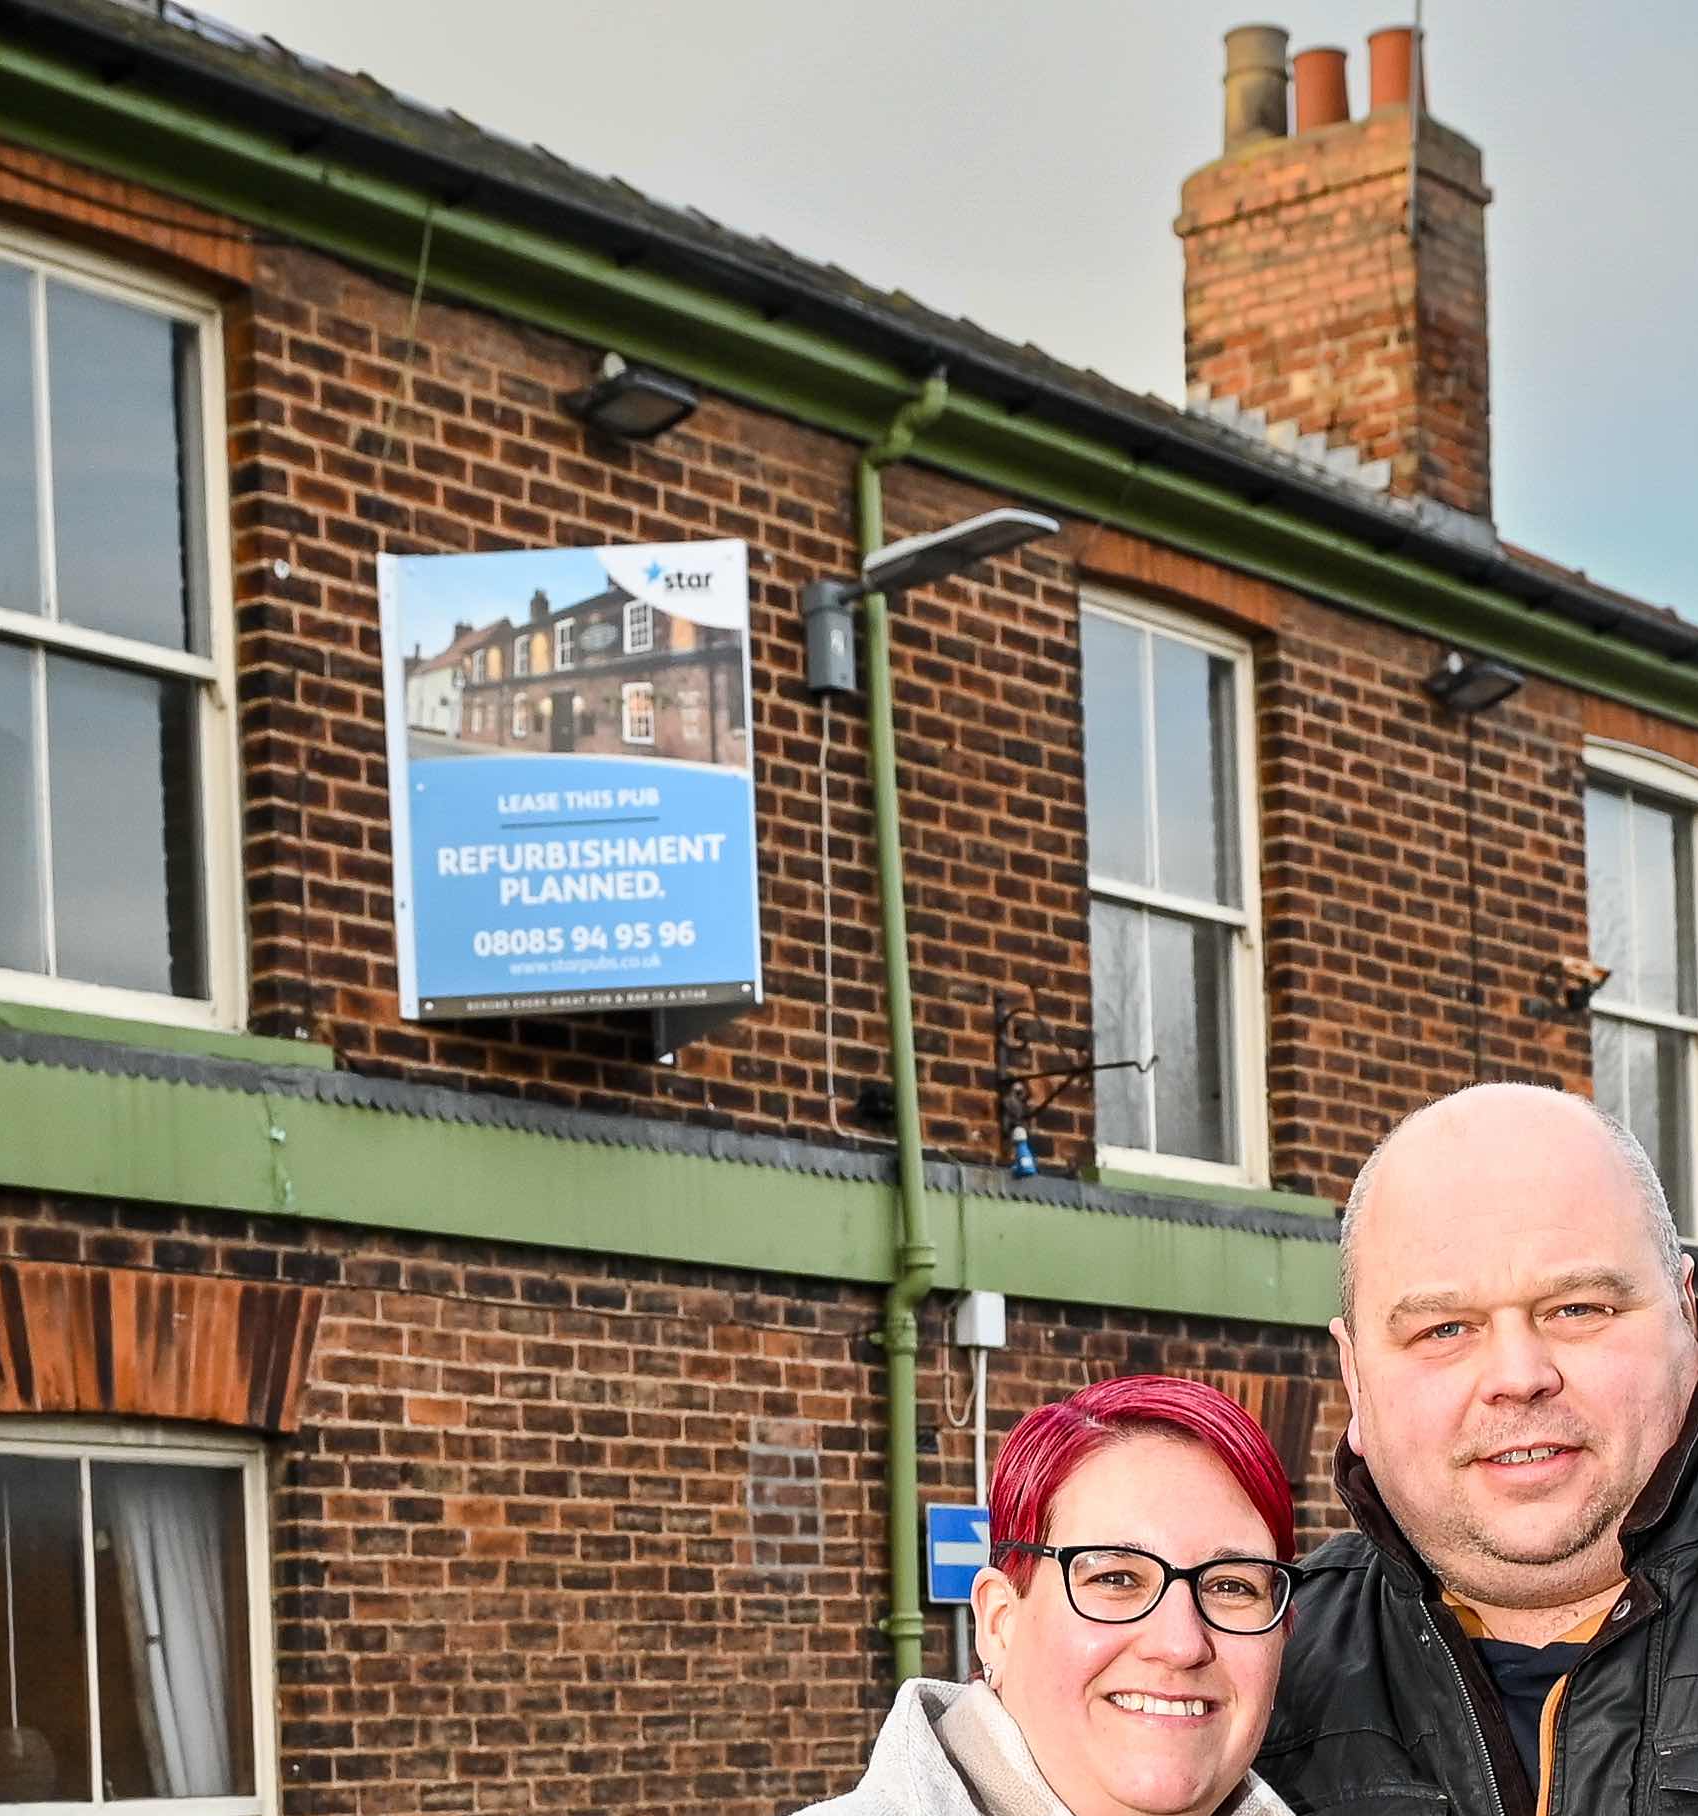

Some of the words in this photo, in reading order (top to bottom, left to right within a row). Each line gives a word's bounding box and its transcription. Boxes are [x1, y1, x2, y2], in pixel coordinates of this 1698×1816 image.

[663, 571, 713, 589] star
[498, 792, 560, 814] LEASE
[566, 789, 613, 810] THIS
[618, 787, 660, 808] PUB
[437, 833, 726, 876] REFURBISHMENT
[499, 870, 667, 906] PLANNED.
[473, 927, 565, 957] 08085
[570, 924, 608, 952] 94
[614, 921, 652, 950] 95
[658, 919, 696, 947] 96
